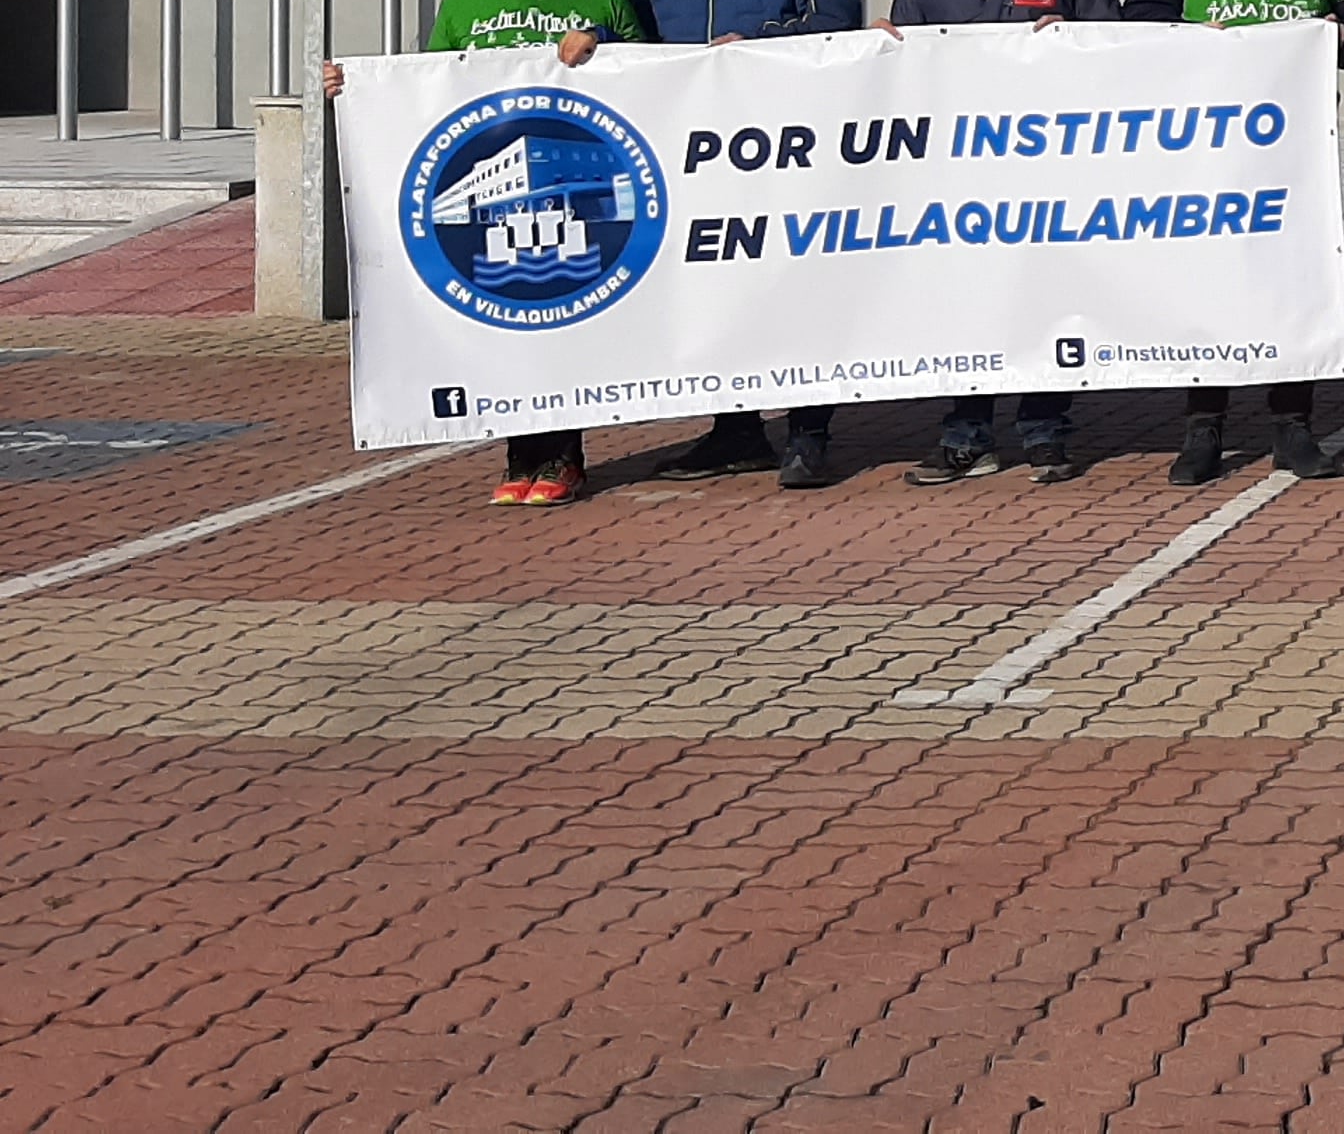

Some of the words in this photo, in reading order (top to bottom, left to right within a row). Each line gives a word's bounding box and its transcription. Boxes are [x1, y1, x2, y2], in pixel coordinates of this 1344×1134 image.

[411, 105, 497, 238] PLATAFORMA
[501, 95, 551, 113] POR
[557, 98, 590, 118] UN
[591, 112, 660, 219] INSTITUTO
[684, 126, 817, 174] POR
[840, 117, 932, 165] UN
[950, 102, 1287, 158] INSTITUTO
[684, 215, 769, 263] EN
[783, 188, 1289, 257] VILLAQUILAMBRE
[445, 279, 472, 305] EN
[475, 266, 631, 324] VILLAQUILAMBRE
[475, 397, 523, 416] Por
[532, 393, 565, 410] un
[575, 375, 722, 406] INSTITUTO
[731, 373, 763, 391] en
[771, 352, 1004, 387] VILLAQUILAMBRE
[1094, 342, 1279, 367] @InstitutoVqYa
